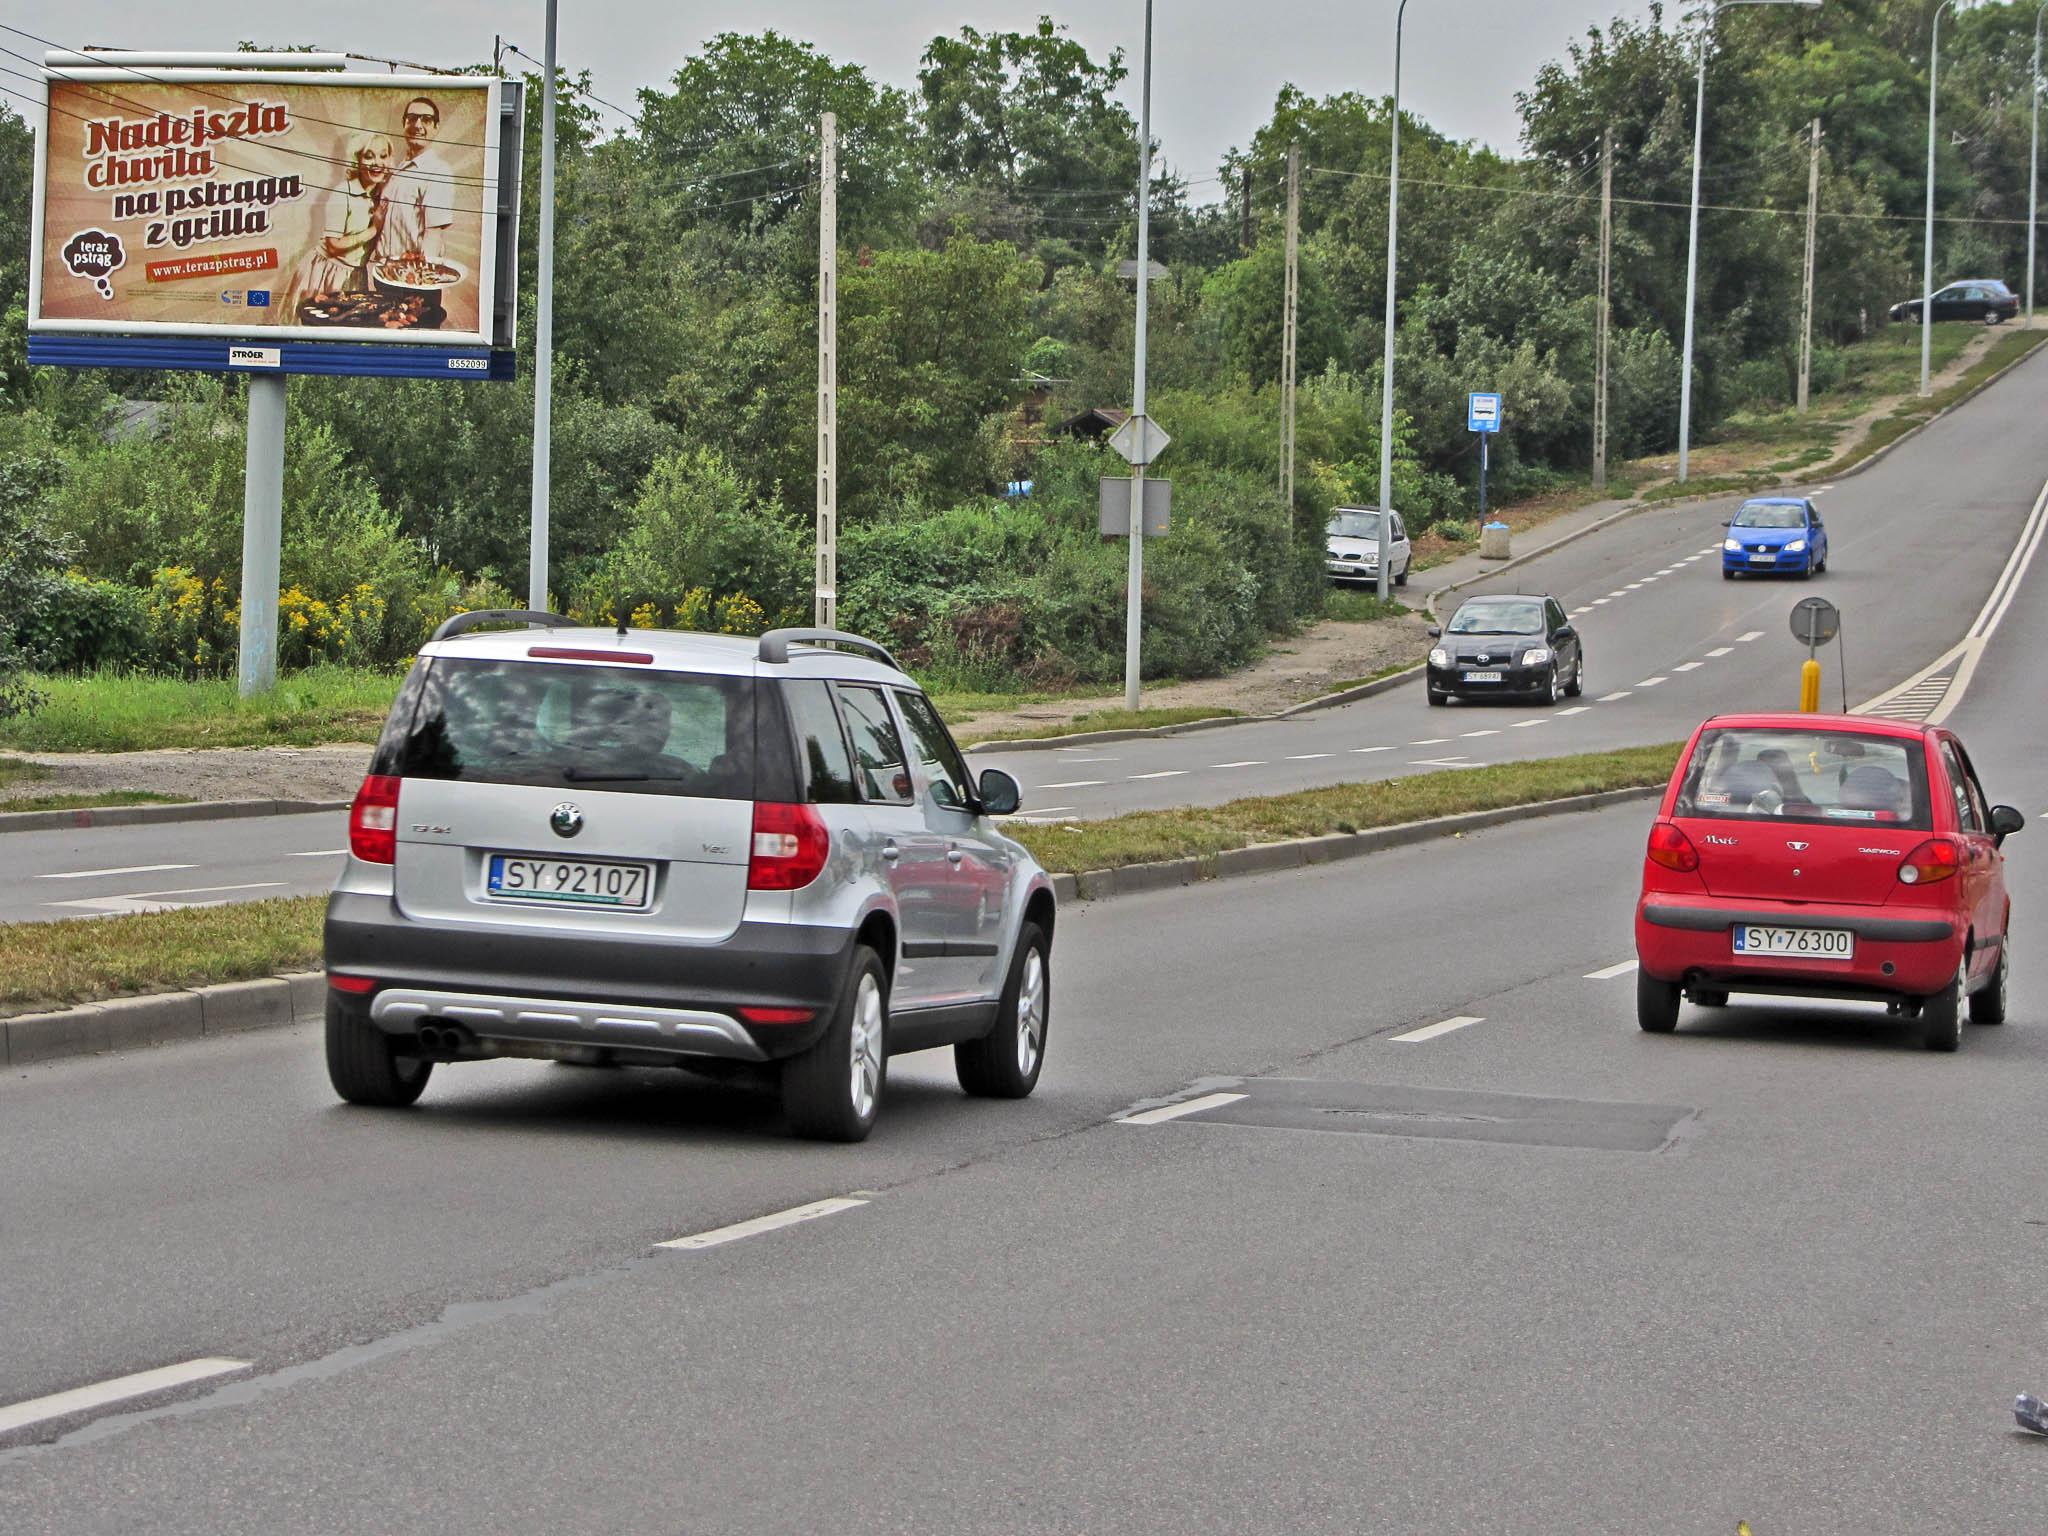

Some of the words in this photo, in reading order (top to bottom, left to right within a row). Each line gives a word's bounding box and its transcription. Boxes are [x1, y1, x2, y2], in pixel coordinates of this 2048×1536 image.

[87, 147, 215, 188] chwila
[115, 192, 162, 218] na
[147, 222, 167, 245] z
[172, 208, 270, 247] grilla
[80, 240, 109, 253] teraz
[152, 252, 268, 276] www.terazpstrag.pl
[449, 359, 486, 369] 8552099
[1858, 848, 1901, 856] DAEWOO
[507, 861, 546, 889] SY
[555, 864, 641, 896] 92107
[1748, 929, 1777, 949] SY
[1785, 930, 1848, 952] 76300
